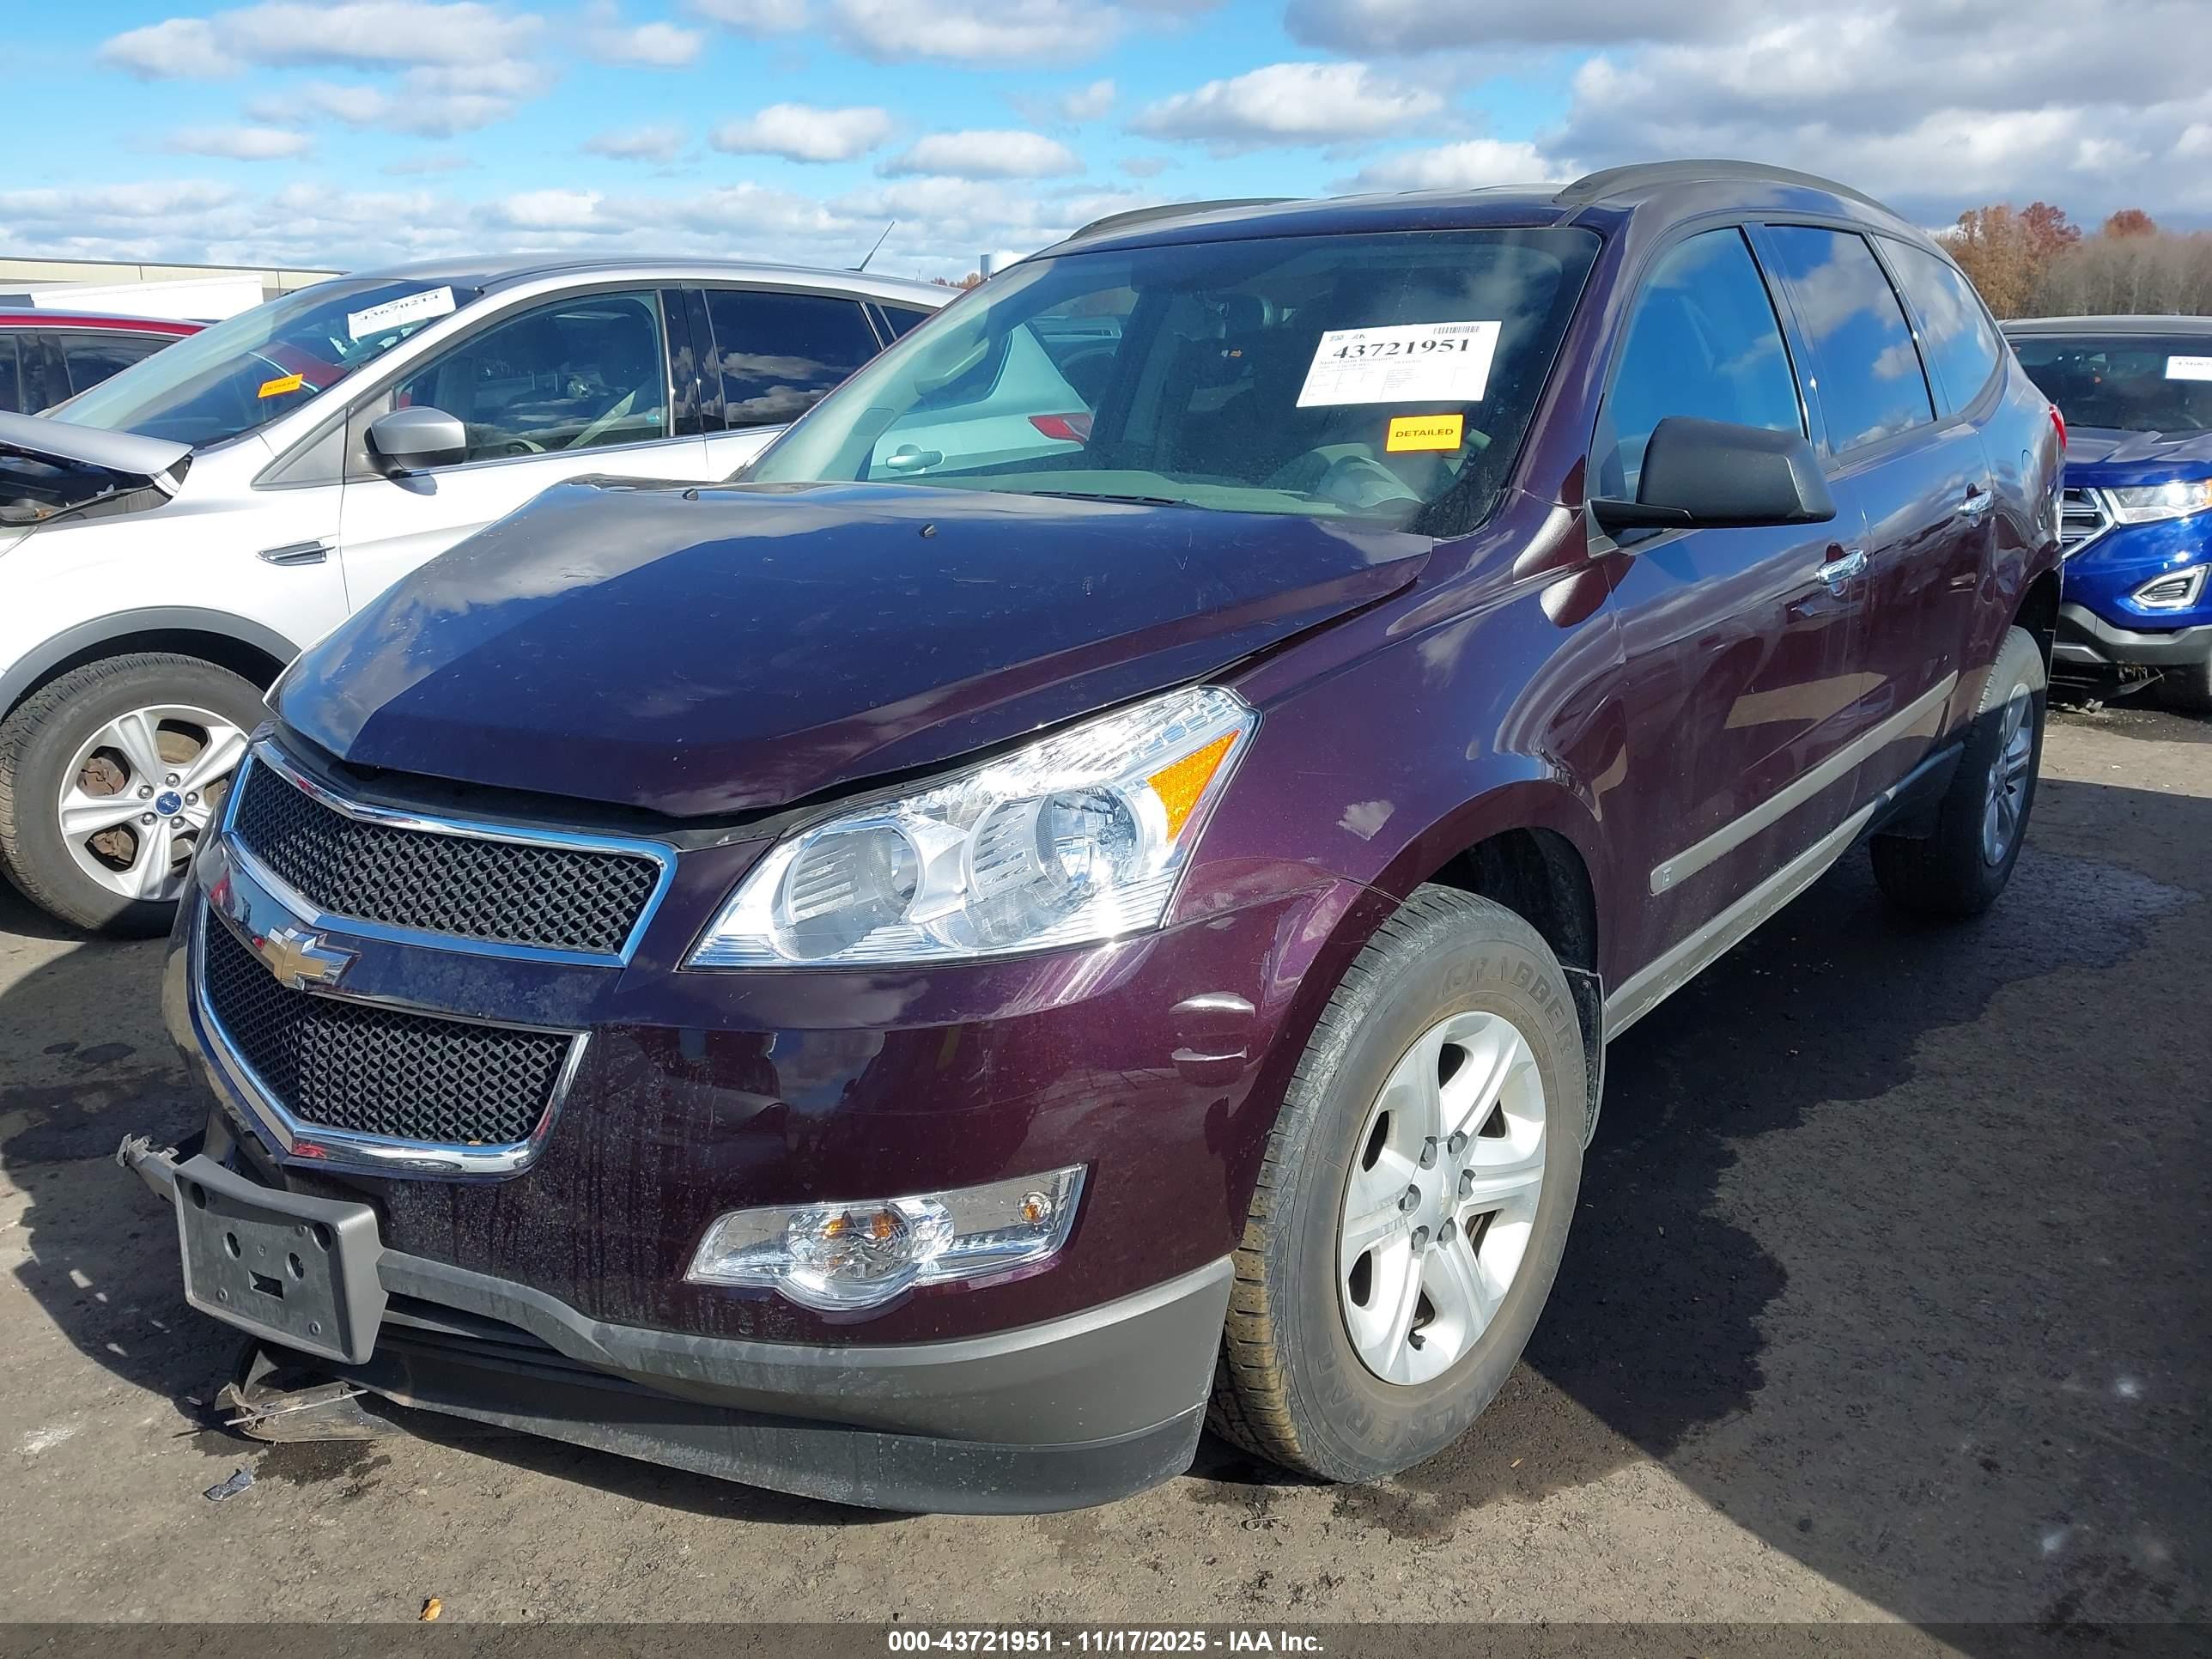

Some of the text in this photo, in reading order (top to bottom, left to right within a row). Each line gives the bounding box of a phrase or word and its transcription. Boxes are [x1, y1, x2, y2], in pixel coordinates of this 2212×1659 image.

[1333, 337, 1470, 359] 43721951
[1395, 428, 1454, 438] DETAILED
[1442, 955, 1577, 1057] GRABBER
